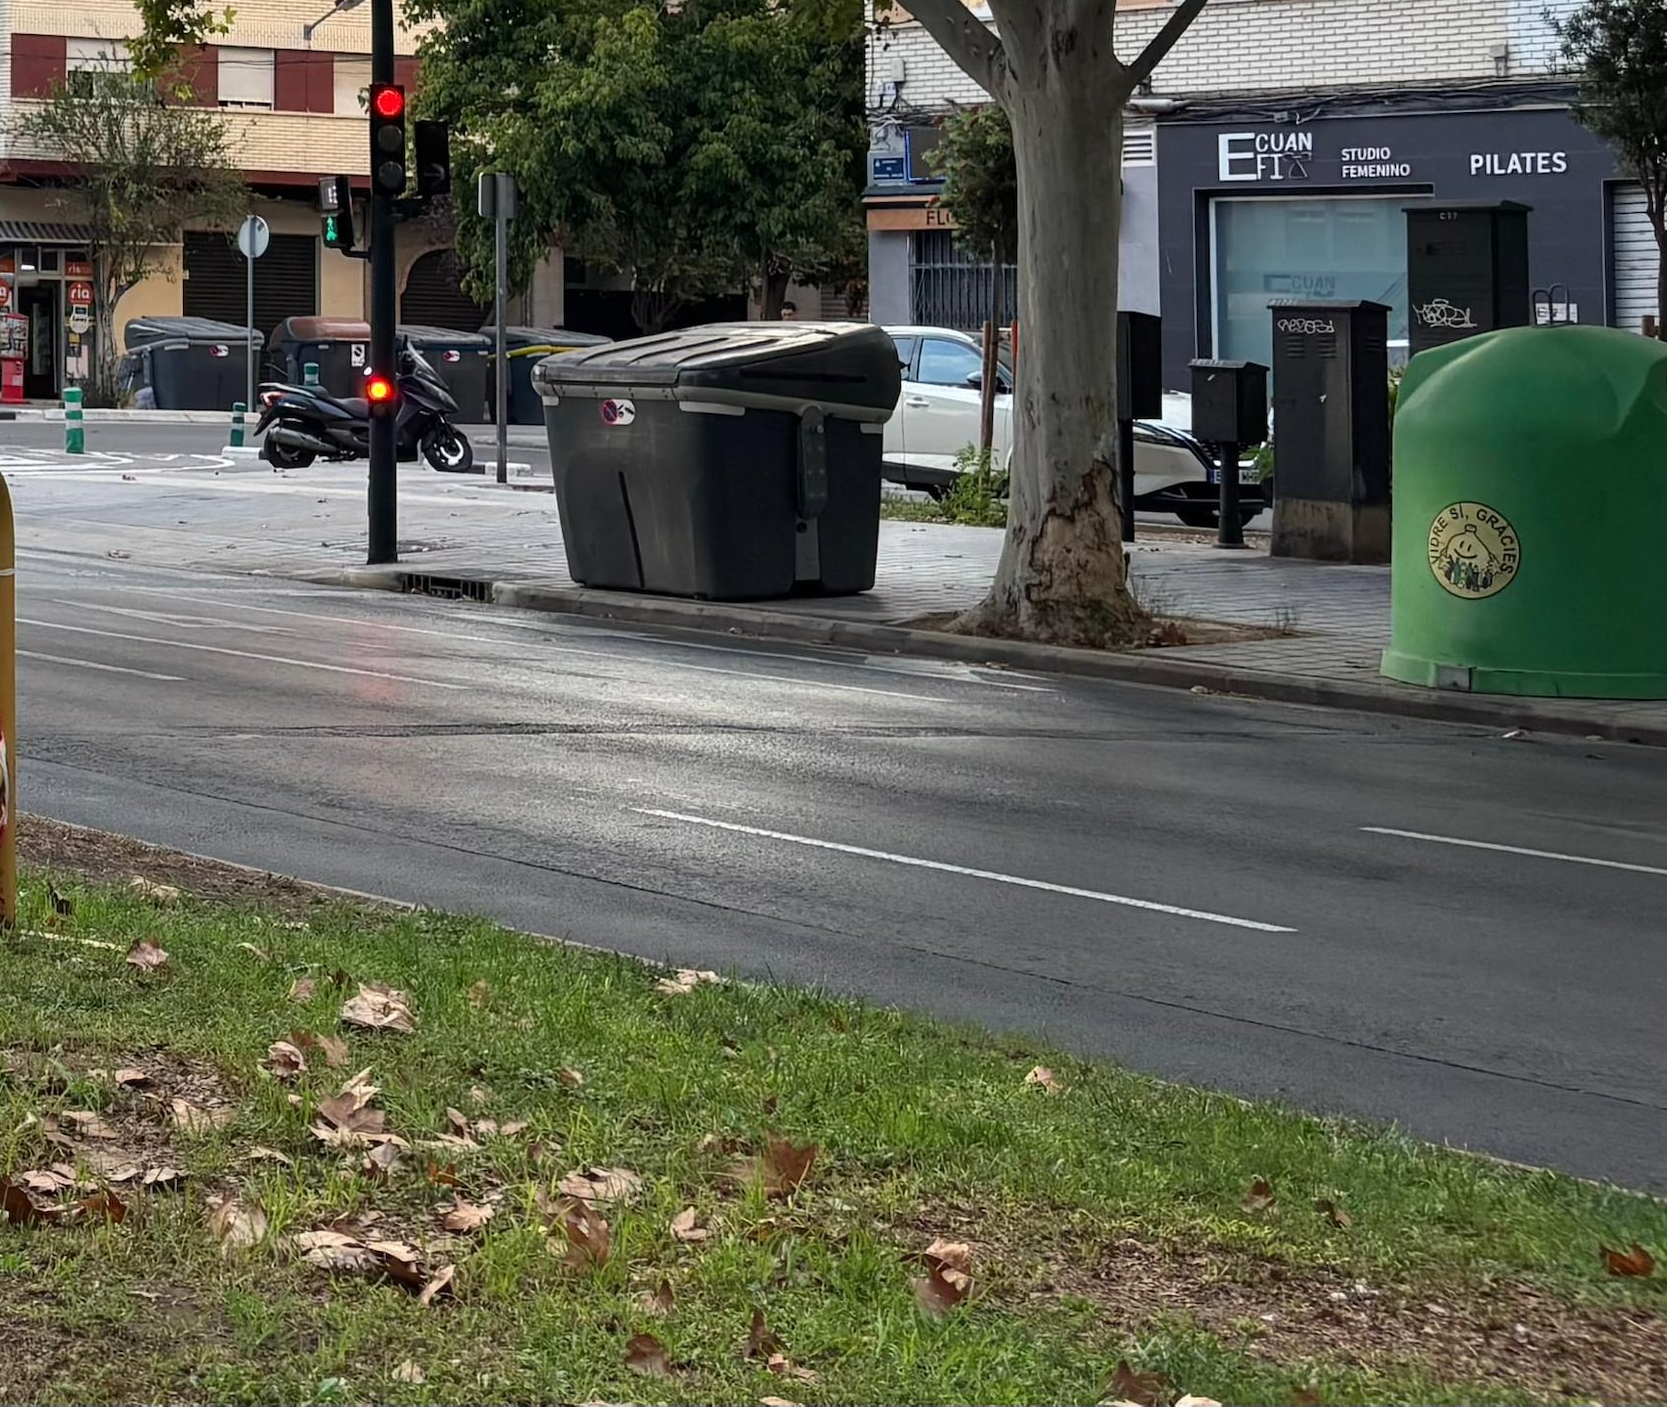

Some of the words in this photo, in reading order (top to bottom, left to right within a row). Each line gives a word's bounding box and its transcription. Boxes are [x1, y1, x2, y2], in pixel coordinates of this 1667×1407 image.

[1341, 146, 1391, 161] STUDIO
[1342, 163, 1411, 178] FEMENINO
[1470, 151, 1567, 175] PILATES
[70, 284, 91, 299] ria
[1430, 517, 1448, 564] VIDRE
